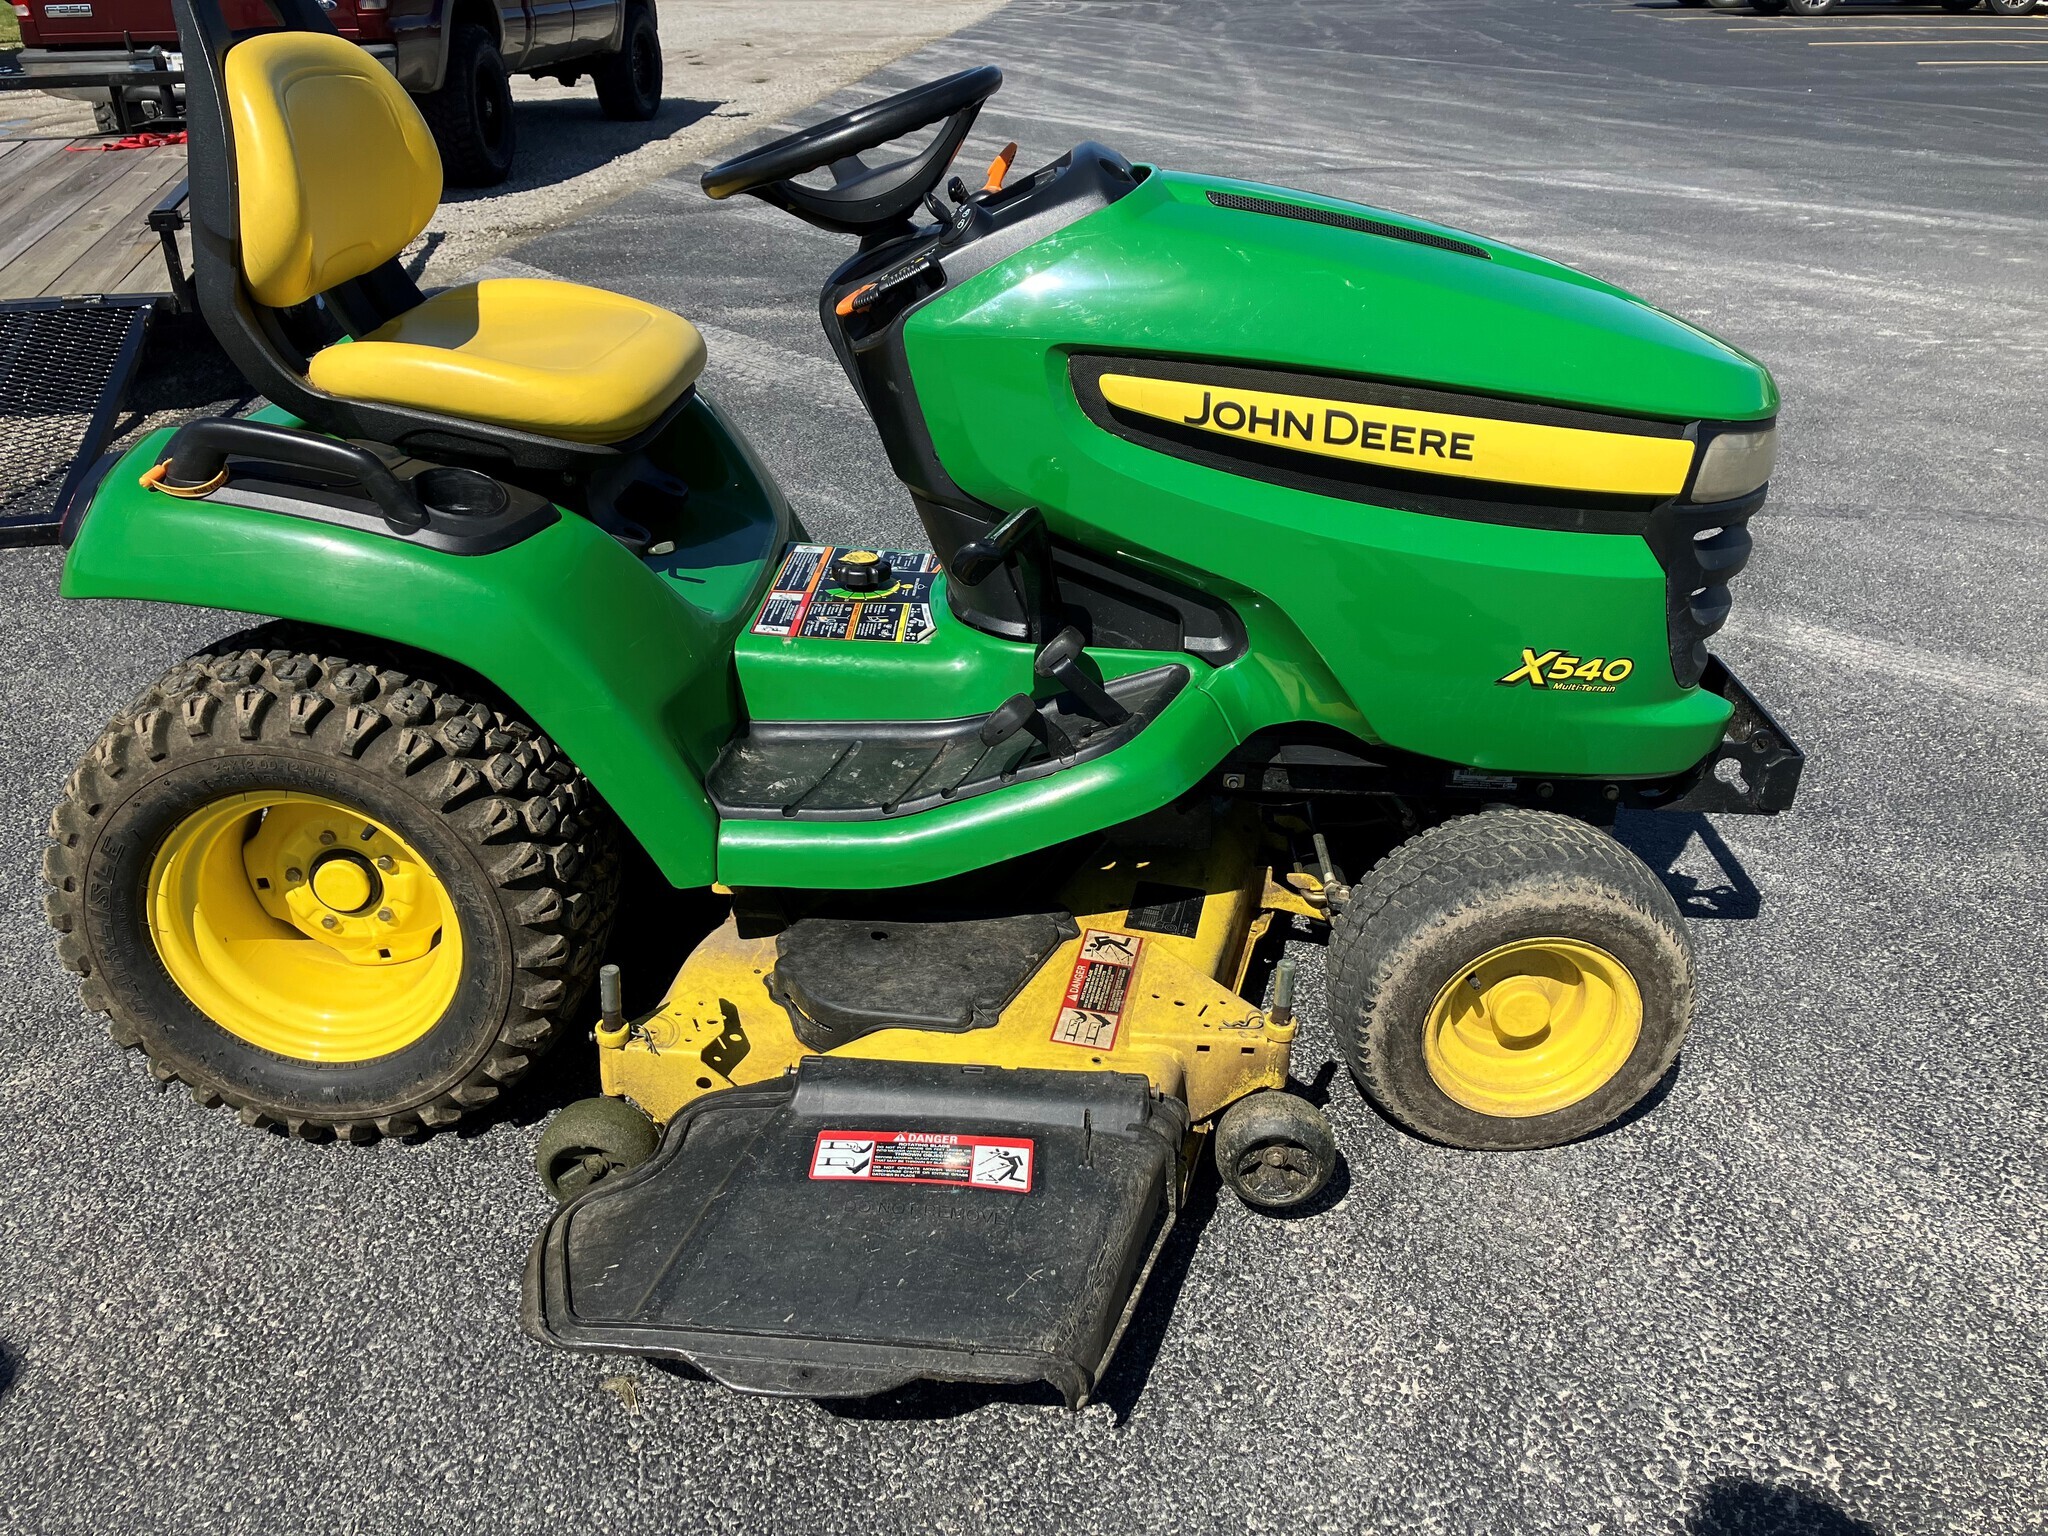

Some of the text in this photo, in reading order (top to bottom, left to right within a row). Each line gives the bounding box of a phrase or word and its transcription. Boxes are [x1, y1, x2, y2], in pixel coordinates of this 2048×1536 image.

[1184, 391, 1475, 461] JOHN DEERE
[1496, 647, 1635, 689] X540
[1552, 682, 1616, 693] Multi-Terrain
[1070, 965, 1086, 994] DANGER
[908, 1133, 958, 1144] DANGER
